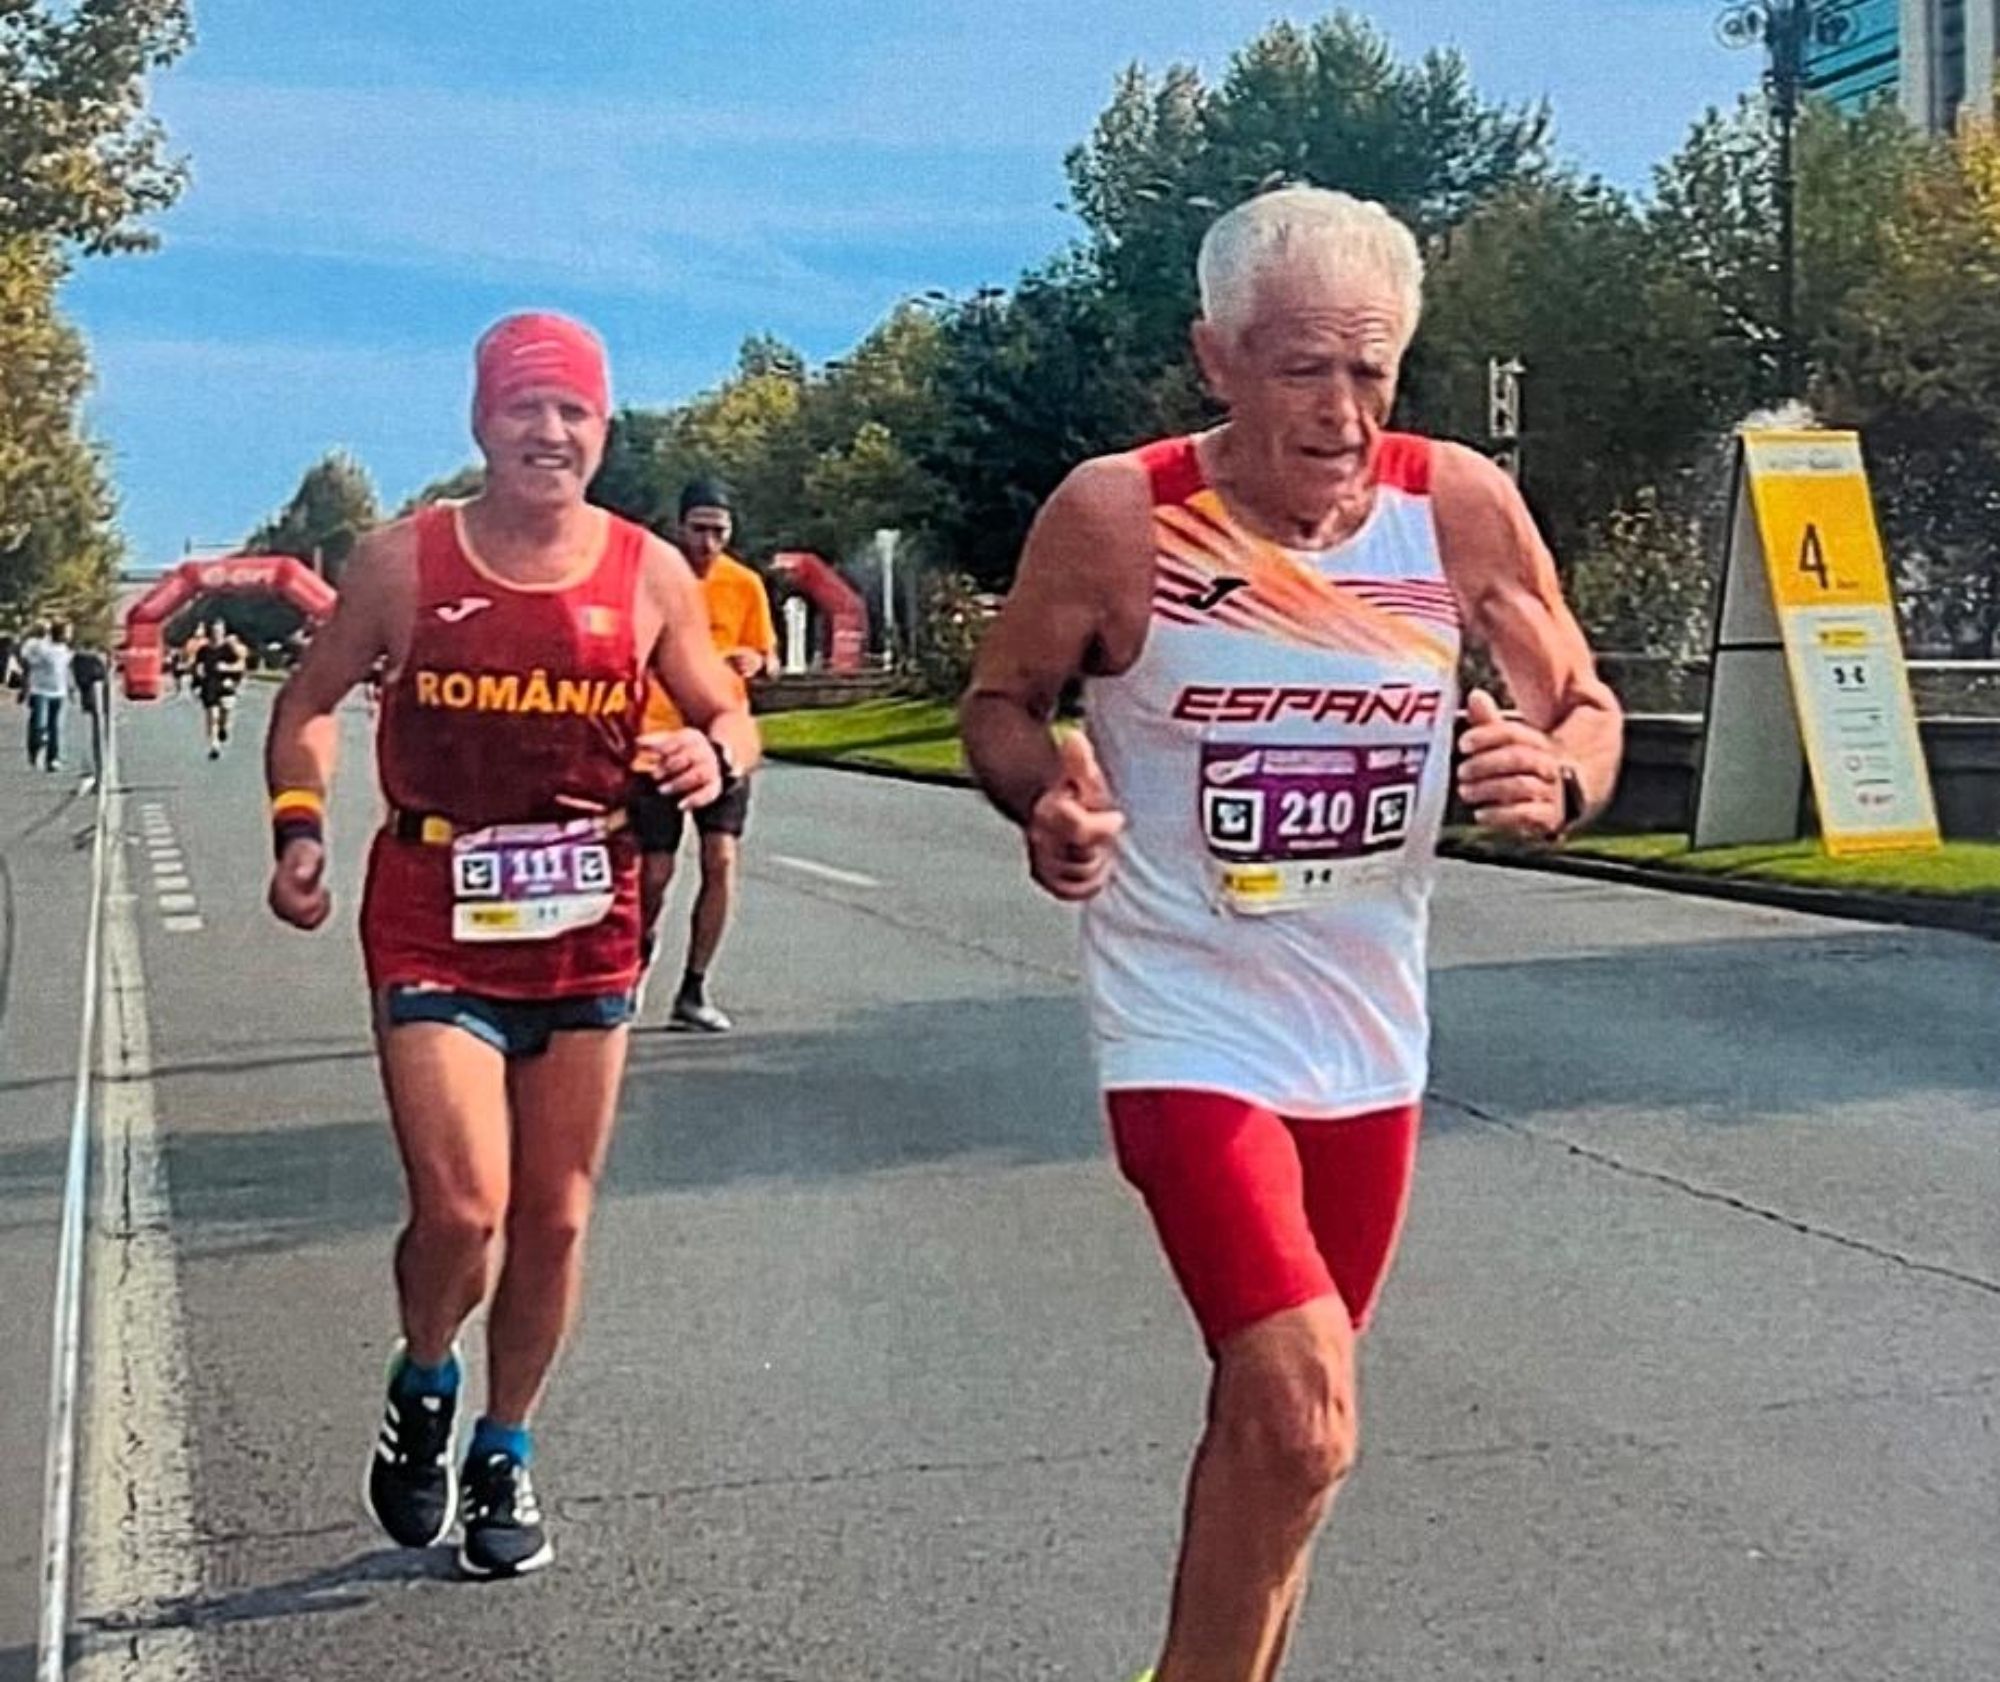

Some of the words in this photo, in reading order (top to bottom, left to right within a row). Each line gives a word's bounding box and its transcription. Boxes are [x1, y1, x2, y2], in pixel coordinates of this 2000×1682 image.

[1798, 522, 1829, 590] 4
[416, 668, 627, 716] ROMÂNIA
[1172, 684, 1441, 724] ESPAÑA
[1278, 789, 1354, 836] 210
[511, 846, 568, 883] 111
